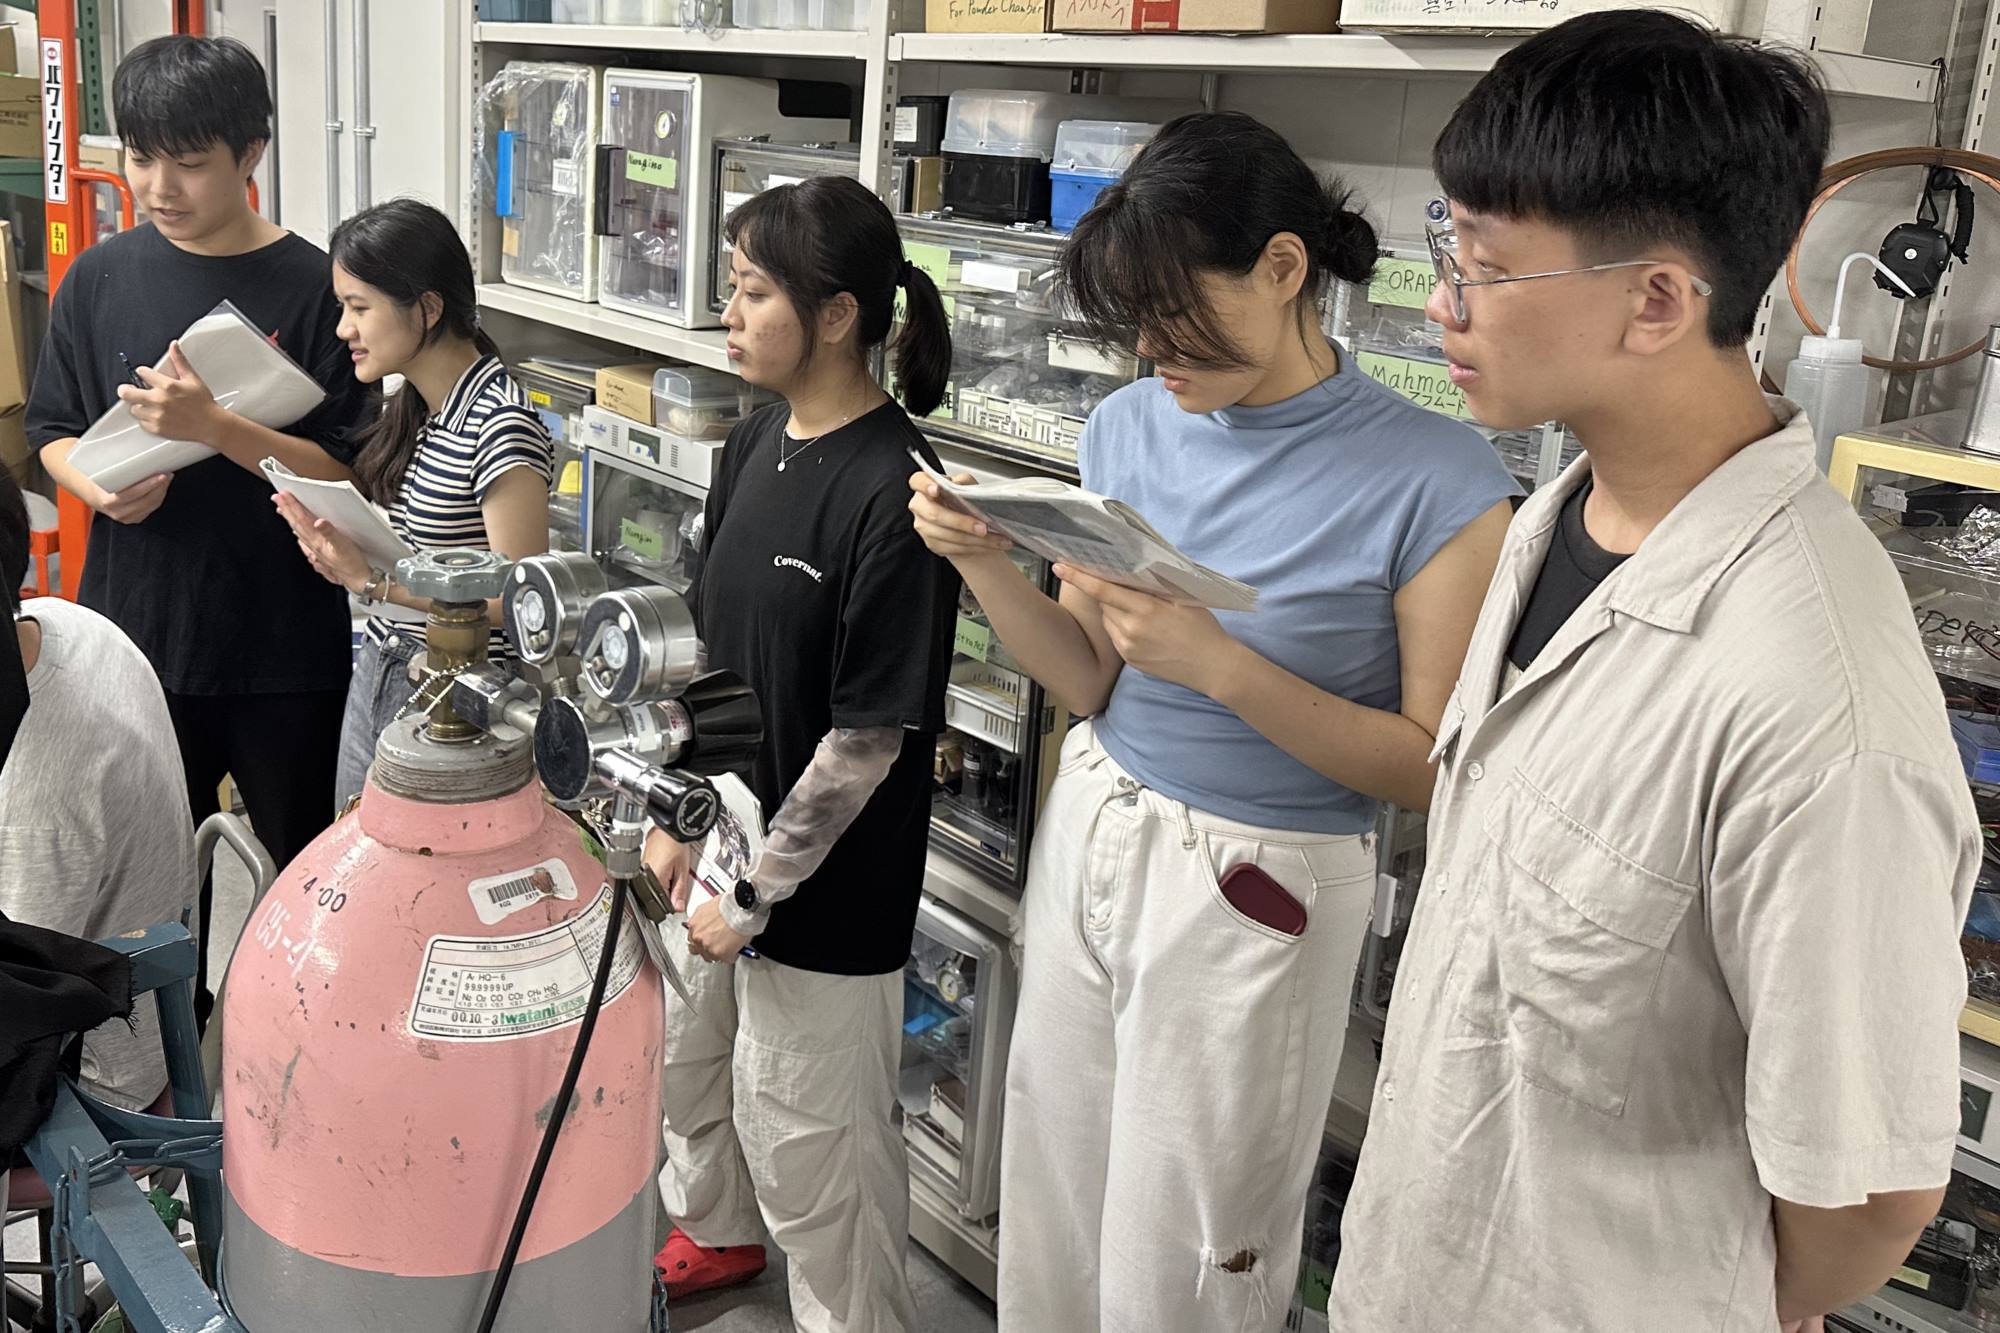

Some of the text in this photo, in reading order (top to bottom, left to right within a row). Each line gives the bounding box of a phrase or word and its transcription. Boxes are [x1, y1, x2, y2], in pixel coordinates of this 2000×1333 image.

[949, 1, 964, 19] For
[46, 65, 63, 194] パワーリフター
[1371, 362, 1466, 399] Mahmou
[499, 1002, 556, 1025] Iwatani
